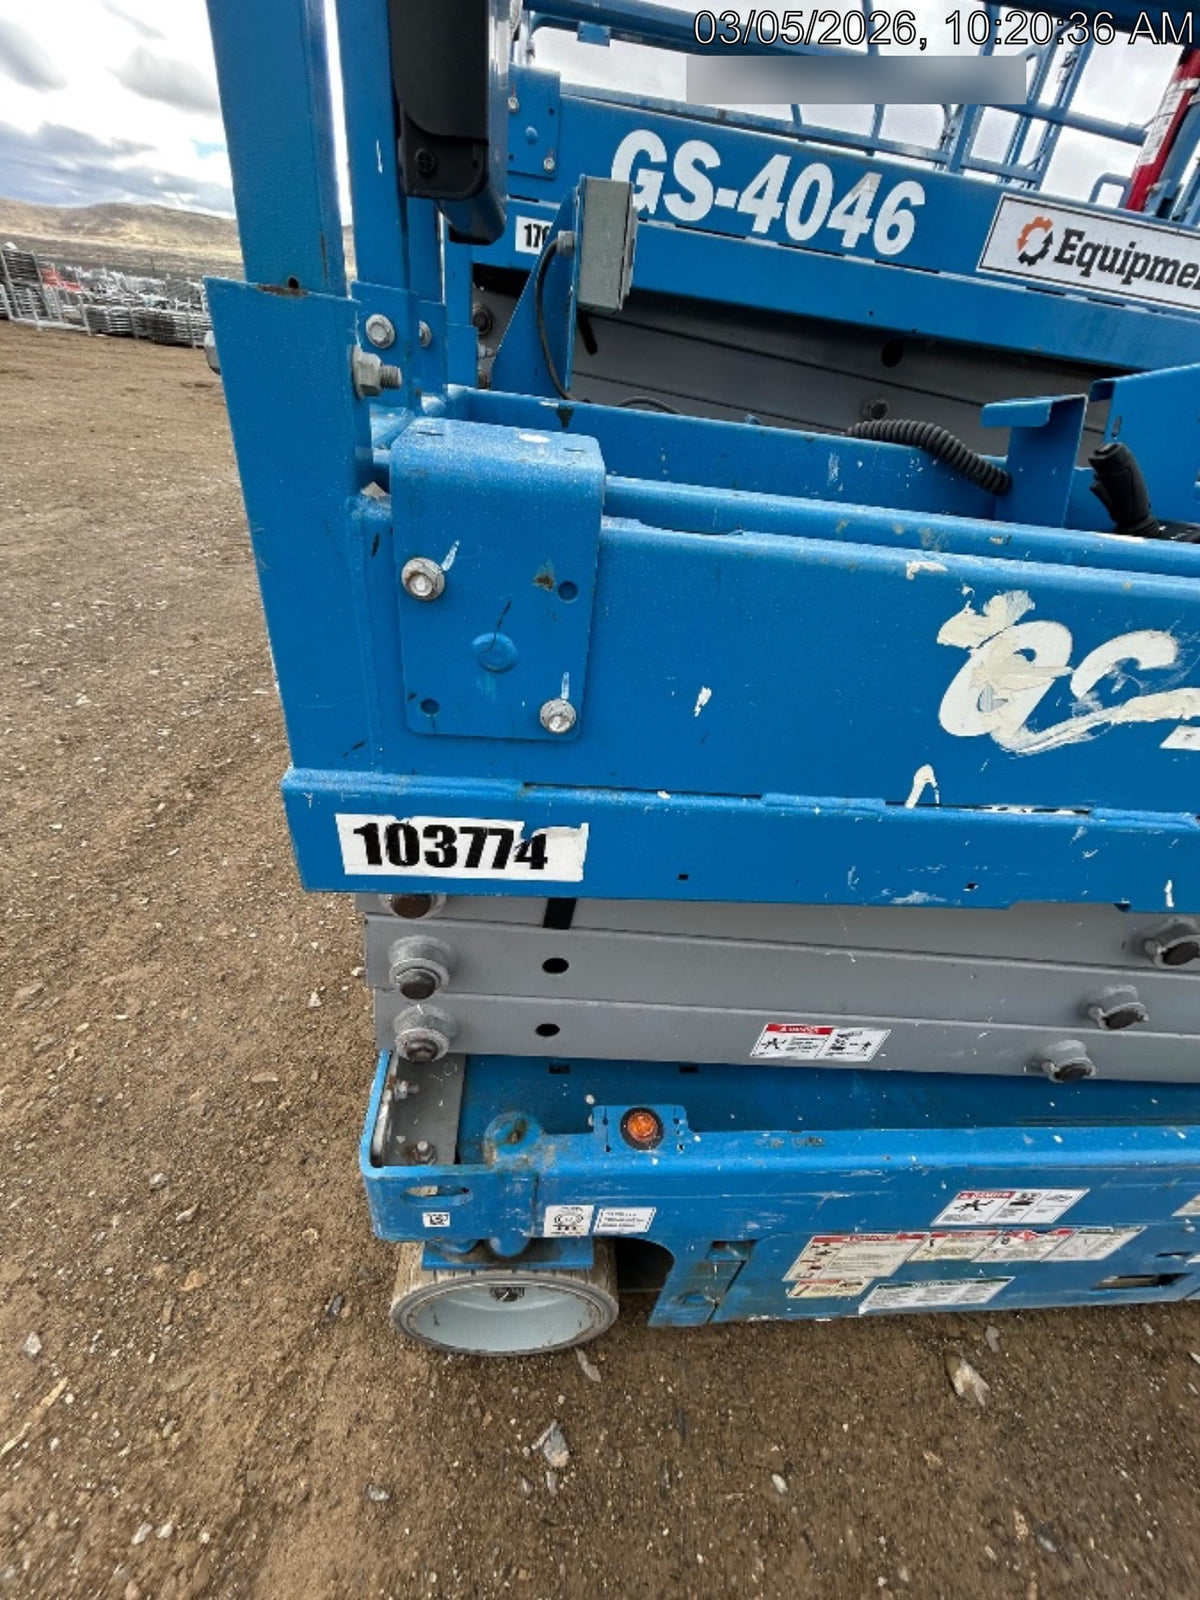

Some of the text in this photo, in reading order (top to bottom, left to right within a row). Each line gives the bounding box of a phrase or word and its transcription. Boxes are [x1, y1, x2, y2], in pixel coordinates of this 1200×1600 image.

[611, 129, 925, 255] GS-4046
[1053, 227, 1200, 290] Equipme
[353, 822, 549, 870] 103774
